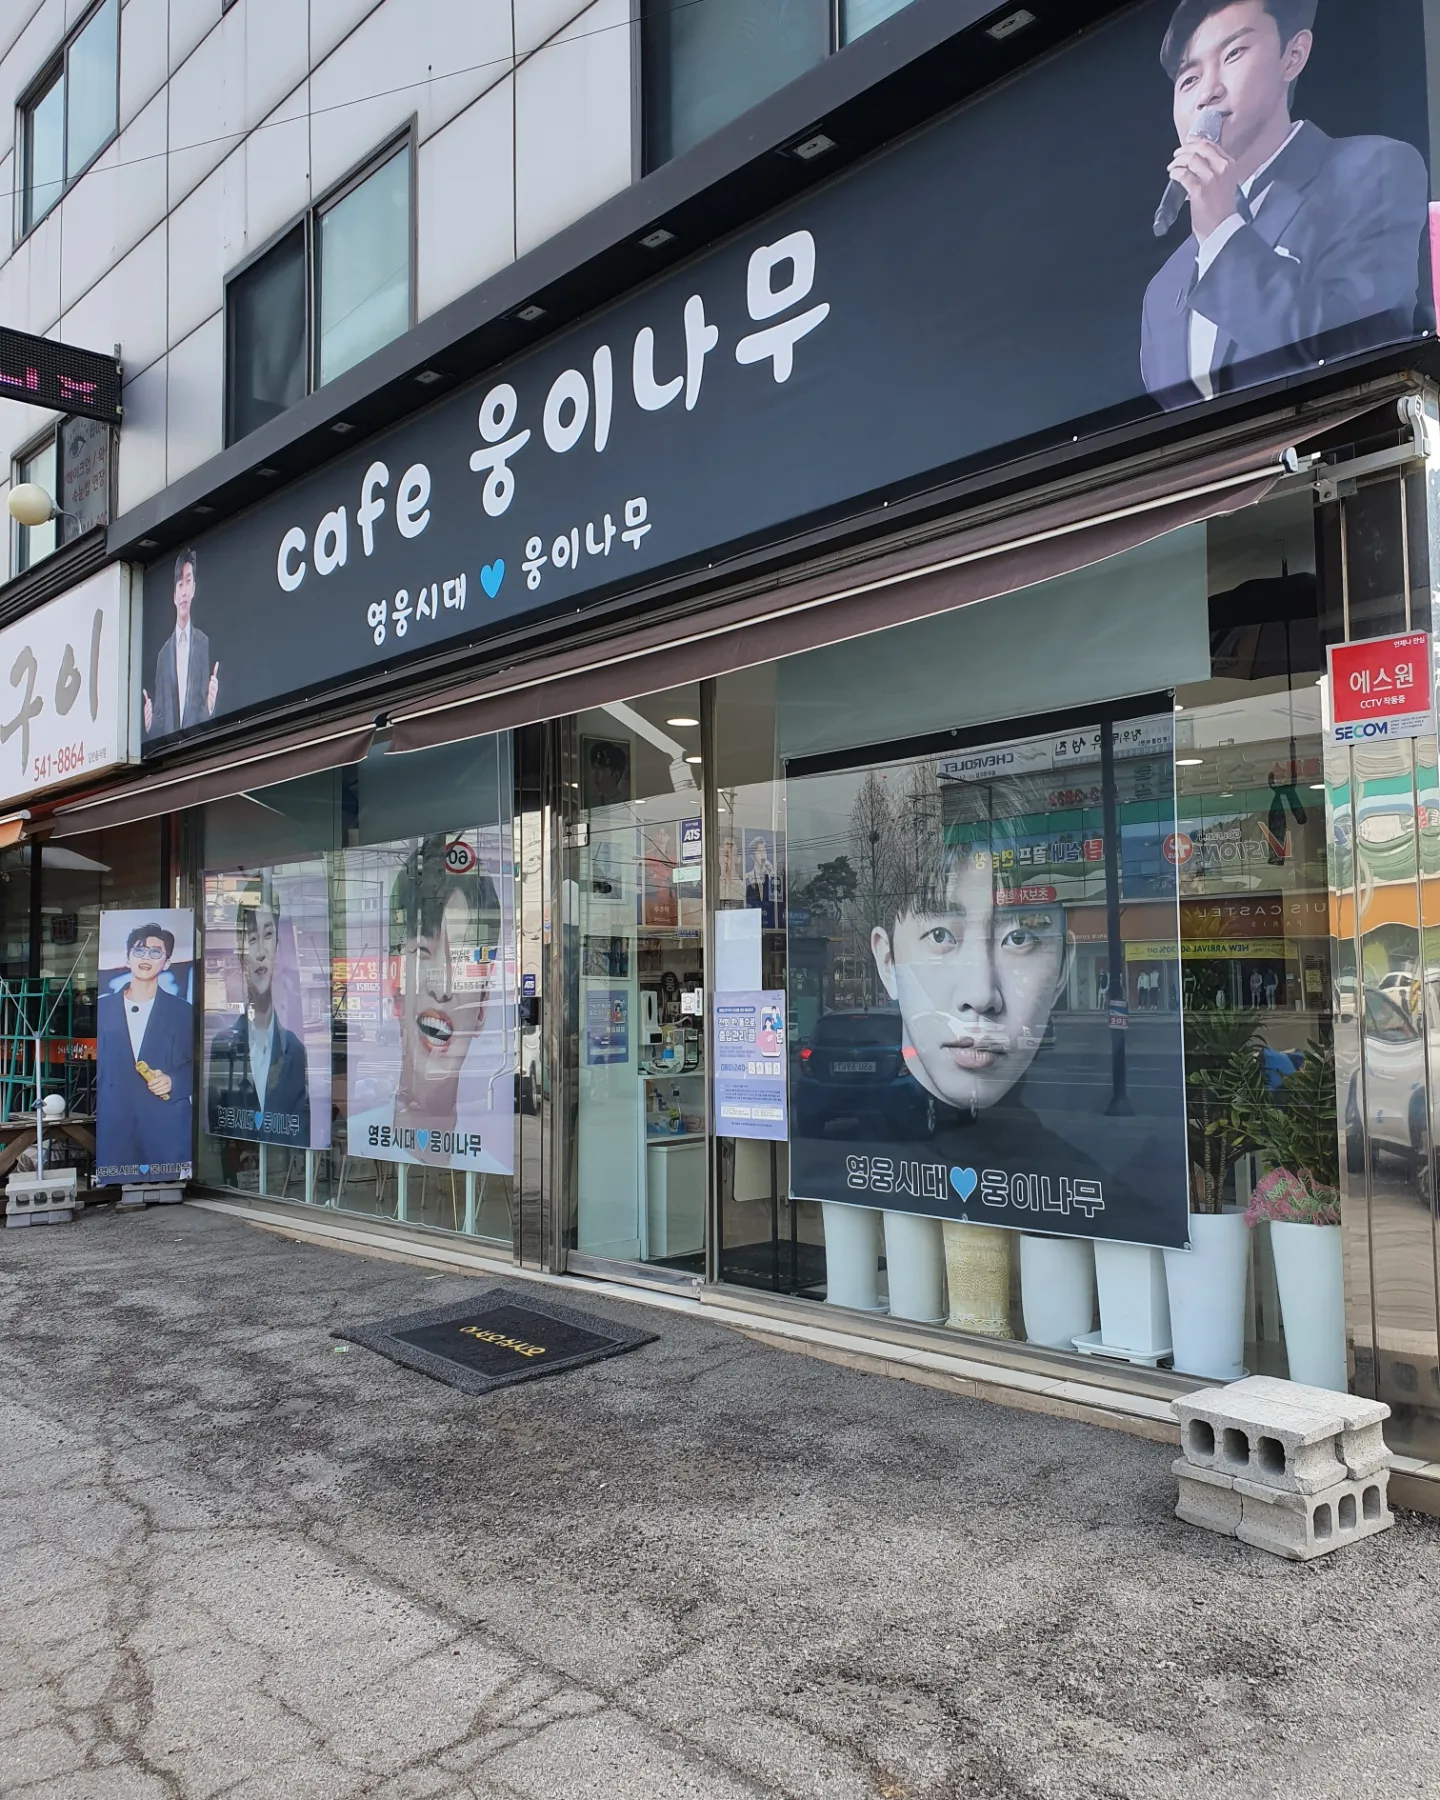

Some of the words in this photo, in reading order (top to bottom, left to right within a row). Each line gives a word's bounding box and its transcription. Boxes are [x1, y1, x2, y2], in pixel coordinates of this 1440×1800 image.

[276, 460, 432, 592] cafe
[468, 229, 831, 518] 웅이나무
[367, 572, 467, 646] 영웅시대
[521, 496, 652, 590] 웅이나무
[1393, 638, 1412, 648] 언제나
[1412, 636, 1426, 646] 안심
[1349, 662, 1415, 695] 에스원
[1360, 698, 1383, 709] CCTV
[1383, 694, 1406, 706] 작동중
[1334, 721, 1388, 741] SECOM
[33, 741, 85, 782] 541-8864
[684, 828, 701, 841] ATS
[217, 1106, 255, 1131] 영웅시대
[263, 1111, 300, 1136] 웅이나무
[368, 1124, 415, 1150] 영웅시대
[430, 1130, 482, 1158] 웅이나무
[97, 1164, 139, 1177] 영웅시대
[845, 1154, 948, 1201] 영웅시대
[980, 1168, 1105, 1219] 웅이나무
